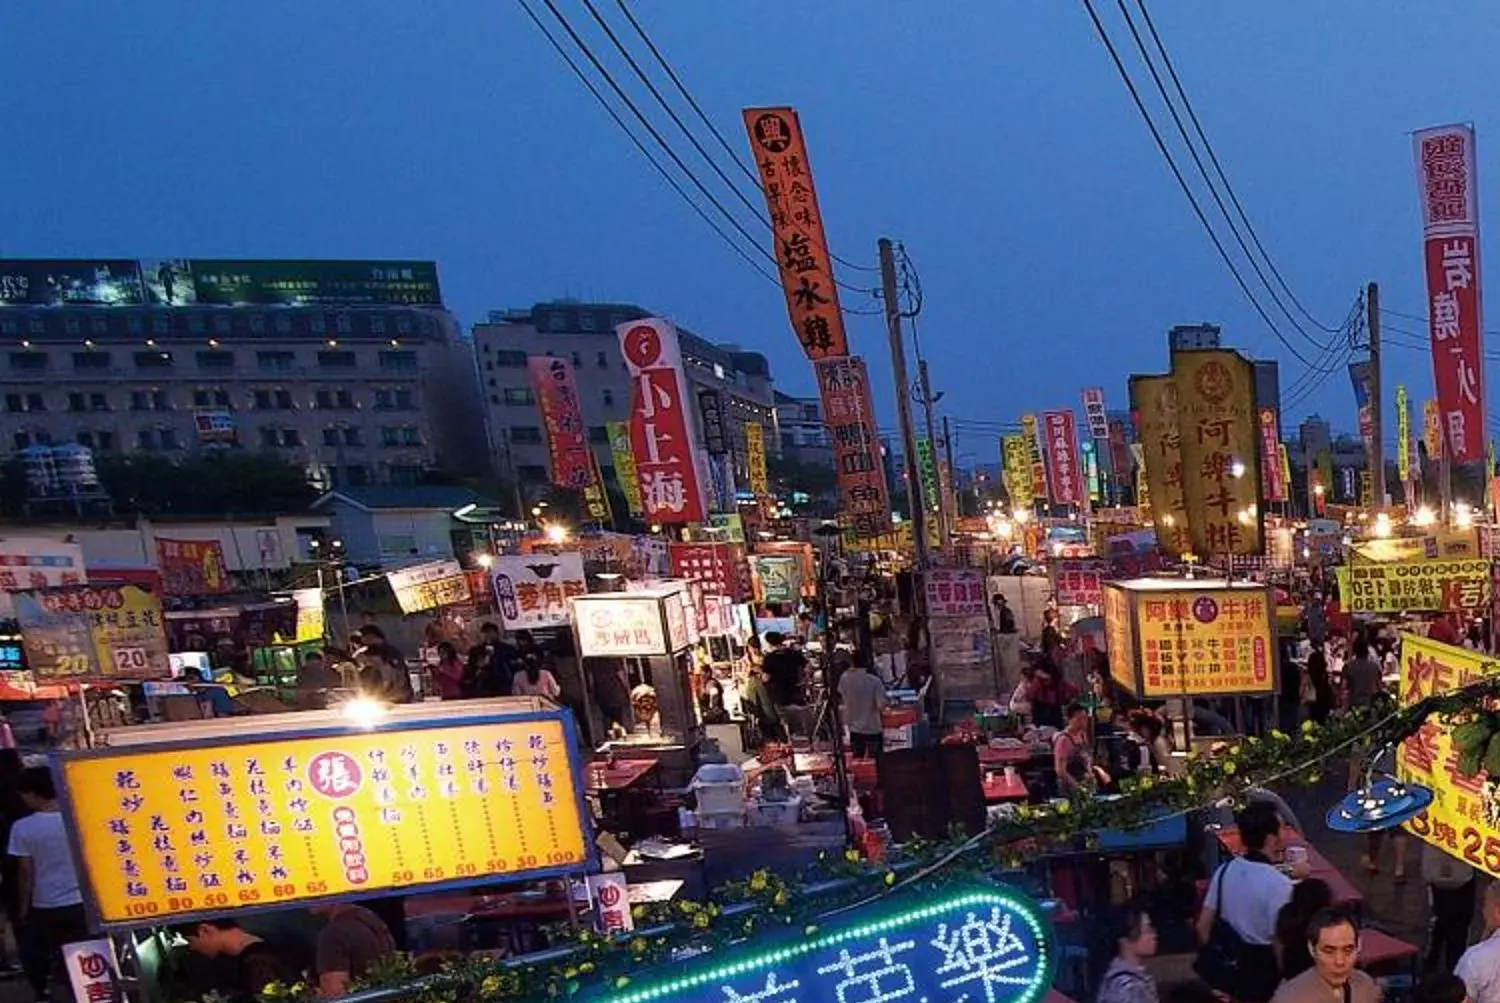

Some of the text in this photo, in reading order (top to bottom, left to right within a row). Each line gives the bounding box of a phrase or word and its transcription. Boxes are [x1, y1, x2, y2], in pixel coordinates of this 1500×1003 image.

[636, 373, 689, 515] 小上海
[57, 654, 88, 674] 20
[116, 651, 145, 668] 20
[317, 753, 359, 793] 張
[546, 850, 575, 864] 100
[423, 867, 445, 879] 65
[306, 880, 328, 894] 65
[237, 889, 261, 903] 65
[124, 901, 158, 916] 100
